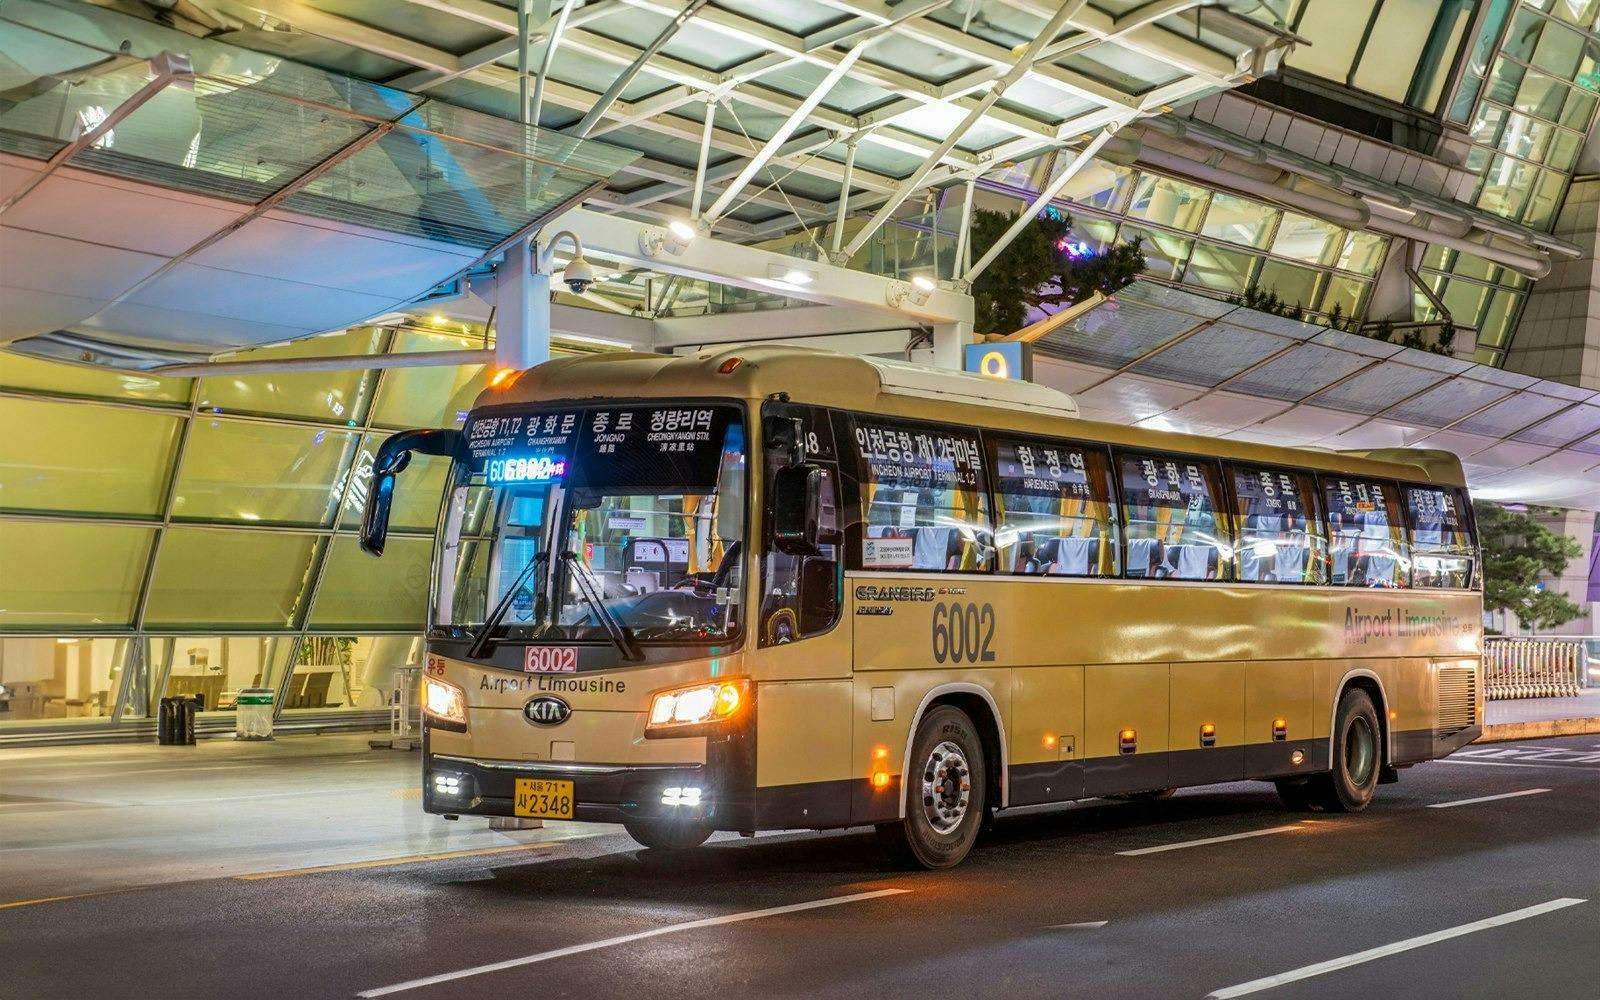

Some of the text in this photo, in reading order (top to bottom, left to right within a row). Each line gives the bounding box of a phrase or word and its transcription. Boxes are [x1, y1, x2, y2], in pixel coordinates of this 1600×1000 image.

[471, 418, 499, 439] 인천공항
[527, 414, 576, 436] 광화문
[592, 412, 633, 433] 종로
[651, 409, 713, 431] 청량리역
[594, 433, 625, 443] JONGNO
[855, 427, 914, 463] 인천공항
[871, 464, 902, 477] INCHEON
[904, 467, 931, 480] AIRPORT
[932, 468, 965, 482] TERMINAL
[1018, 446, 1087, 481] 합정역
[856, 585, 935, 602] GRANBIRD
[932, 602, 996, 664] 6002
[1344, 606, 1460, 643] Airport Limousine
[428, 658, 446, 675] 우등
[528, 647, 575, 671] 6002
[480, 674, 626, 694] Airport Limousine
[529, 701, 562, 720] KIA
